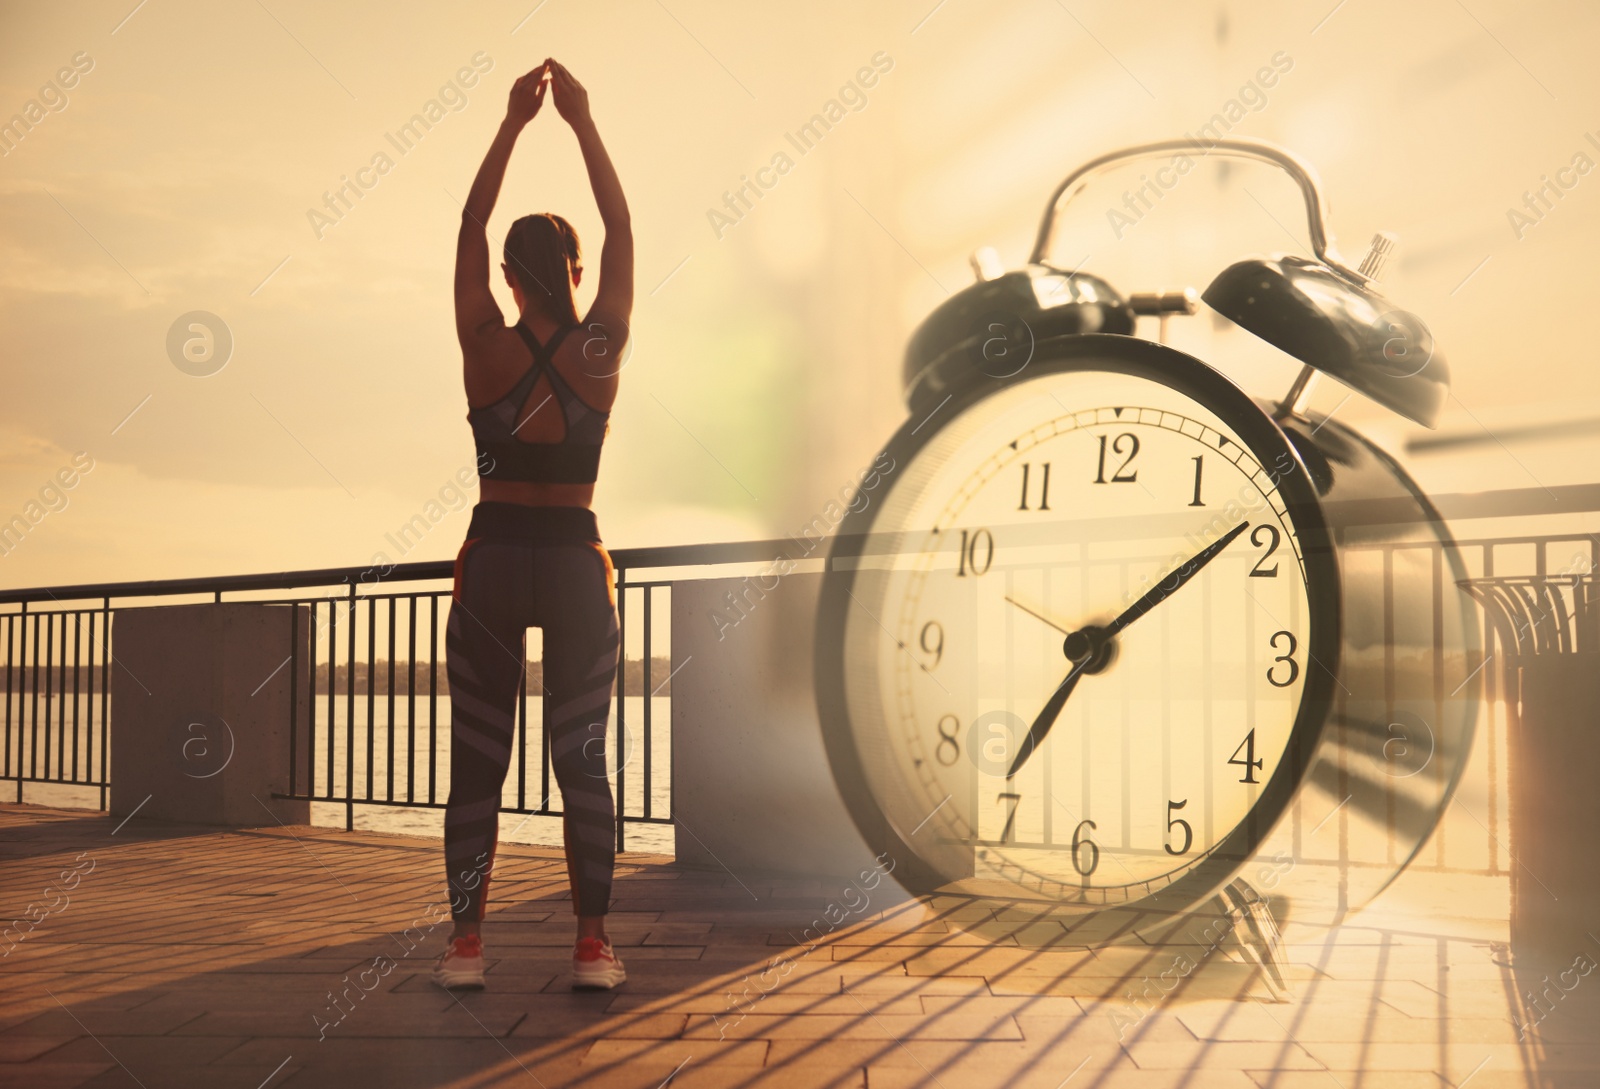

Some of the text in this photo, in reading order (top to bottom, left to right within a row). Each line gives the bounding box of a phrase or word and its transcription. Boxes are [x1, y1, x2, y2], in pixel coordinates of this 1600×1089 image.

[1093, 432, 1140, 484] 12
[1188, 454, 1206, 507] 1
[1018, 462, 1051, 511] 11
[957, 527, 994, 577] 10
[1249, 523, 1281, 578] 2
[920, 620, 944, 672] 9
[1266, 630, 1299, 688] 3
[936, 714, 960, 767] 8
[1227, 727, 1263, 784] 4
[997, 792, 1021, 845] 7
[1164, 799, 1193, 856] 5
[1071, 819, 1099, 877] 6
